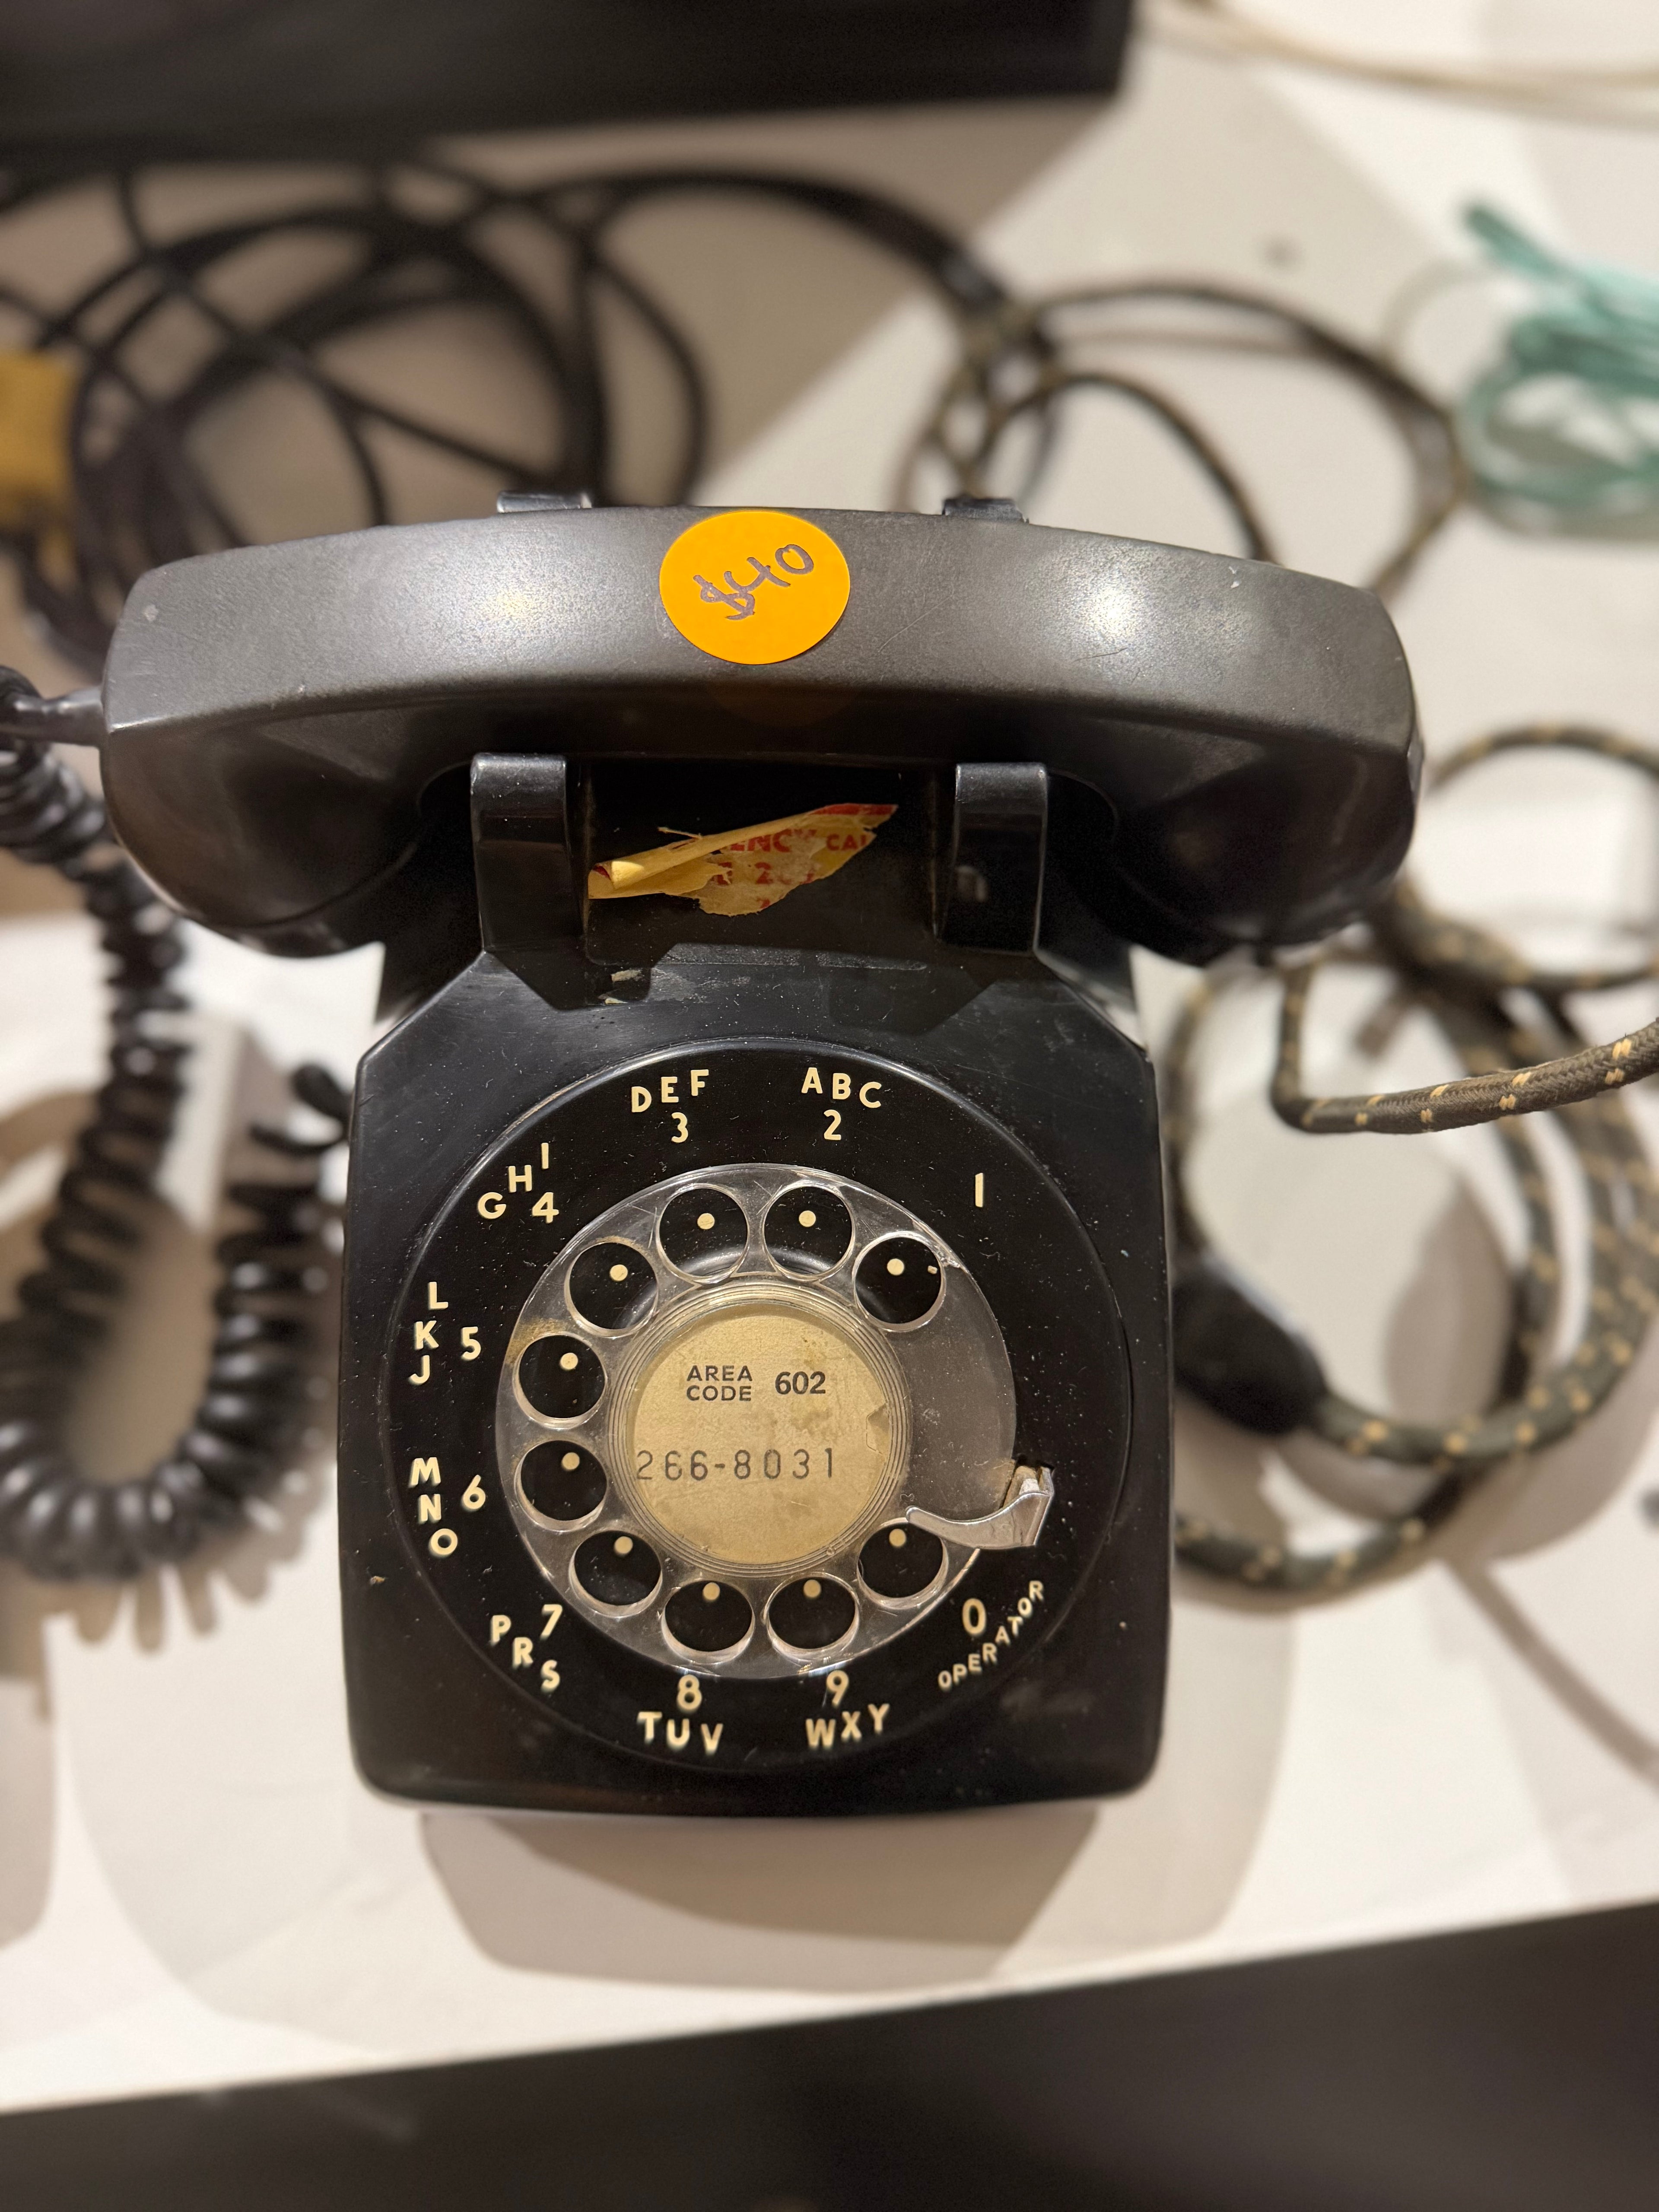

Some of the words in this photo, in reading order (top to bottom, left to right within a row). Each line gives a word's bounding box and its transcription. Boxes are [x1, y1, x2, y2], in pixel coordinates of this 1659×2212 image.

[693, 543, 814, 621] $40
[631, 1068, 709, 1113] DEF
[801, 1067, 882, 1109] ABC
[671, 1111, 689, 1144] 3
[823, 1109, 842, 1141] 2
[531, 1192, 560, 1224] 4
[461, 1326, 482, 1361] 5
[686, 1364, 753, 1382] AREA
[775, 1370, 826, 1395] 602
[686, 1385, 752, 1402] CODE
[636, 1447, 833, 1481] 266-8031
[461, 1474, 486, 1511] 6
[540, 1603, 563, 1638] 7
[938, 1580, 1043, 1688] OPERATOR
[677, 1674, 702, 1711] 8
[826, 1669, 849, 1706] 9
[637, 1711, 723, 1753] TUV
[806, 1703, 890, 1748] WXY
